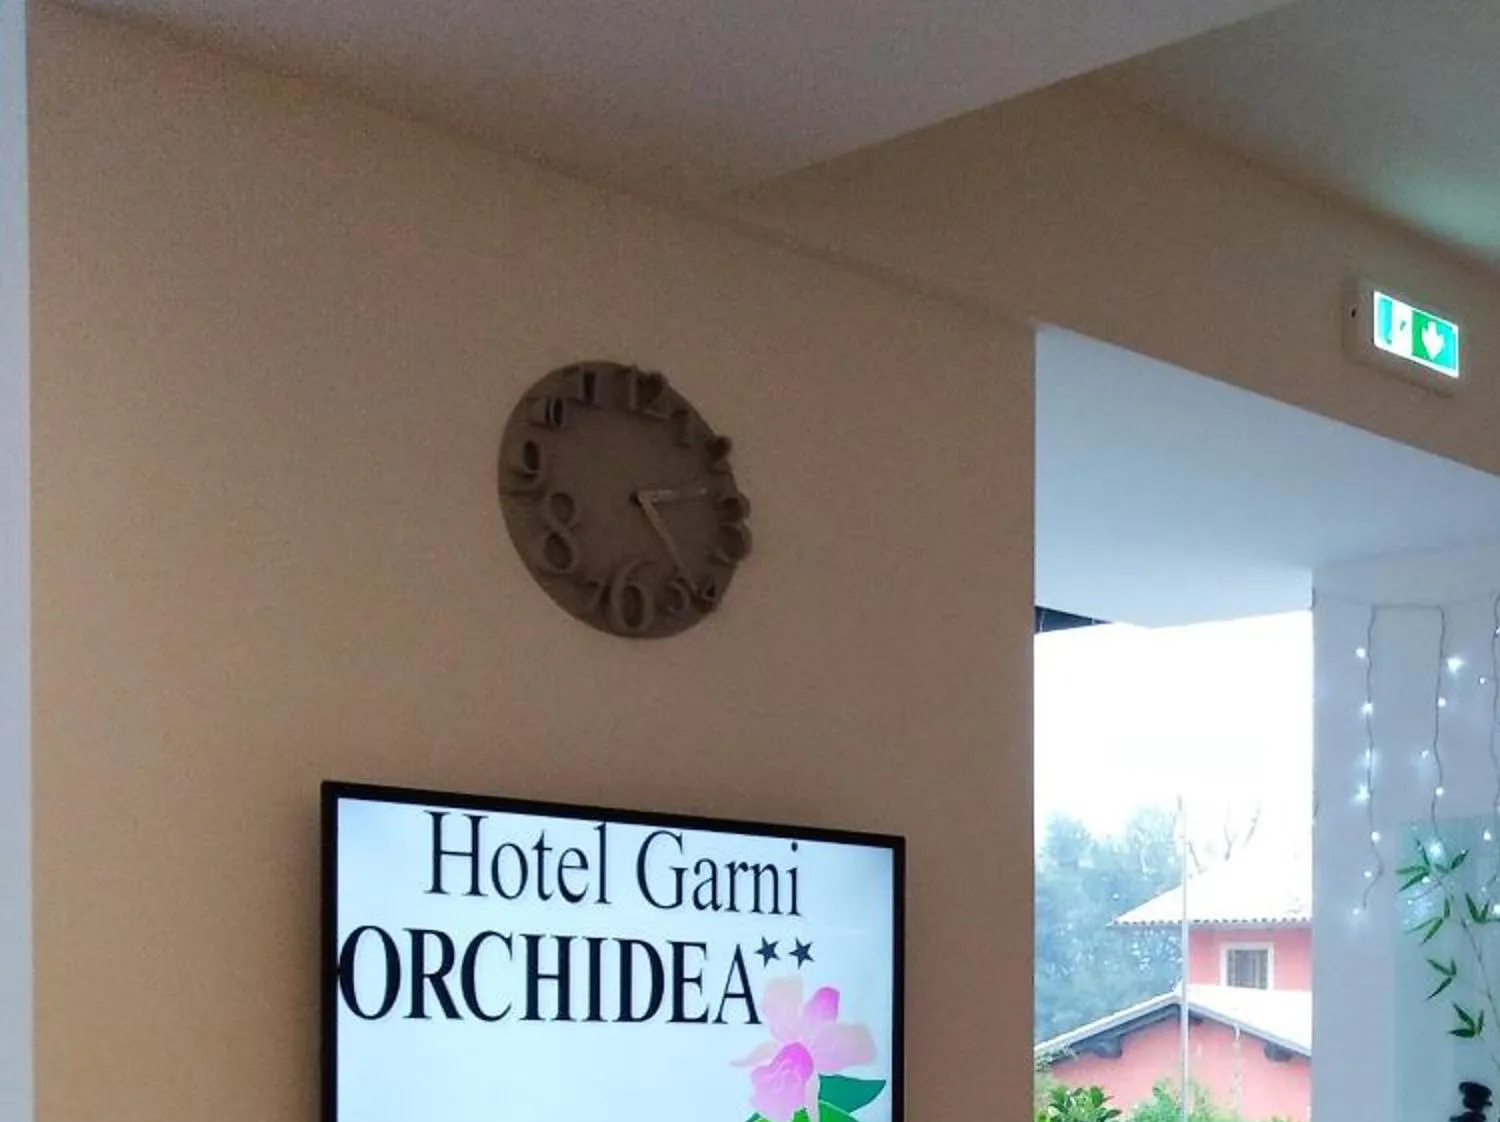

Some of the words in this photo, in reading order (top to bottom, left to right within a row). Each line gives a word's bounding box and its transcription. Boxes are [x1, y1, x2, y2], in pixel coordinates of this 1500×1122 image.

[541, 490, 581, 574] 8
[610, 552, 656, 633] 6
[423, 809, 610, 905] Hotel
[636, 829, 801, 917] Garni
[338, 924, 761, 1025] ORCHIDEA
